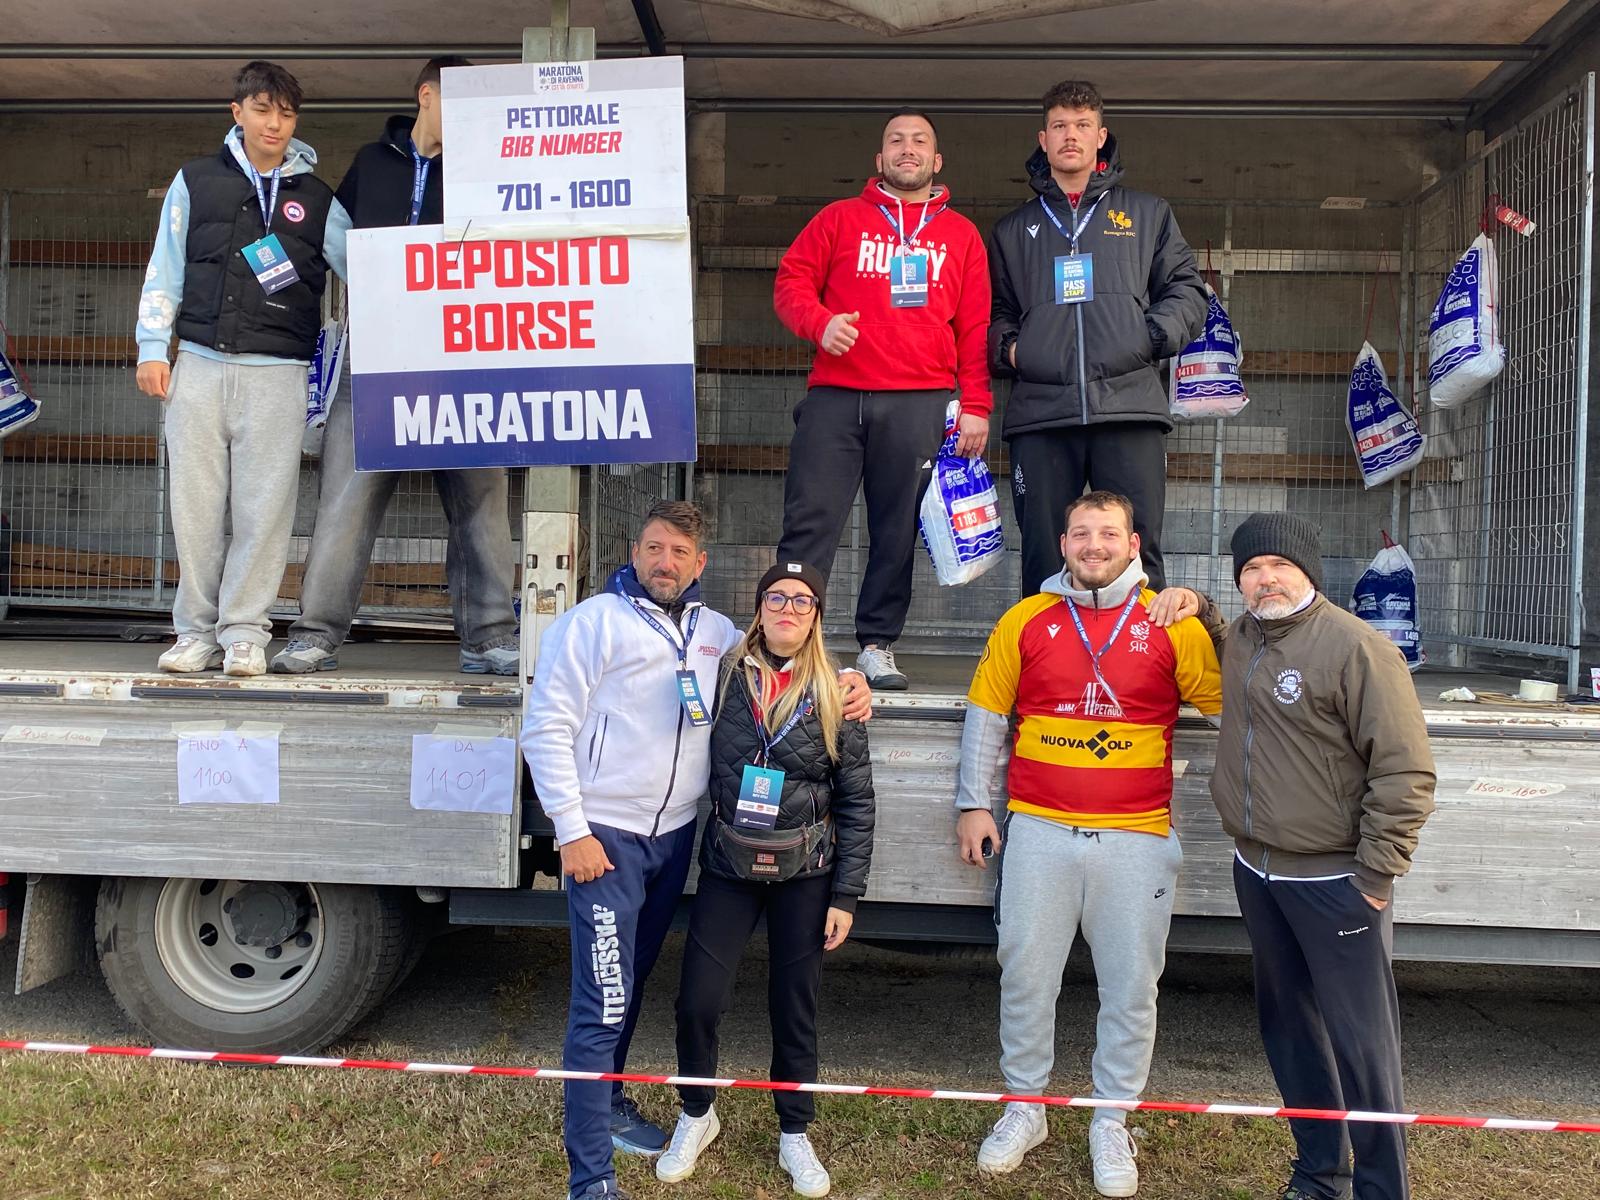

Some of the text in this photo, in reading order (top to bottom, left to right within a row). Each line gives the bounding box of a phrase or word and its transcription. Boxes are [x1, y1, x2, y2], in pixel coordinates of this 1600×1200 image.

[539, 66, 582, 77] MARATONA
[507, 103, 619, 129] PETTORALE
[501, 131, 622, 158] BIB NUMBER
[497, 183, 541, 211] 701
[568, 179, 631, 209] 1600
[861, 232, 947, 252] RAVNNA
[405, 237, 630, 291] DEPOSITO
[1063, 279, 1085, 291] PASS
[443, 300, 595, 353] BORSE
[1178, 365, 1194, 377] 1411
[393, 389, 652, 446] MARATONA
[687, 700, 703, 712] PASS
[189, 738, 249, 752] FINO A
[454, 740, 475, 752] DA
[1041, 734, 1133, 751] NUOVA OLP
[193, 767, 232, 789] 1100
[426, 767, 486, 793] 1101
